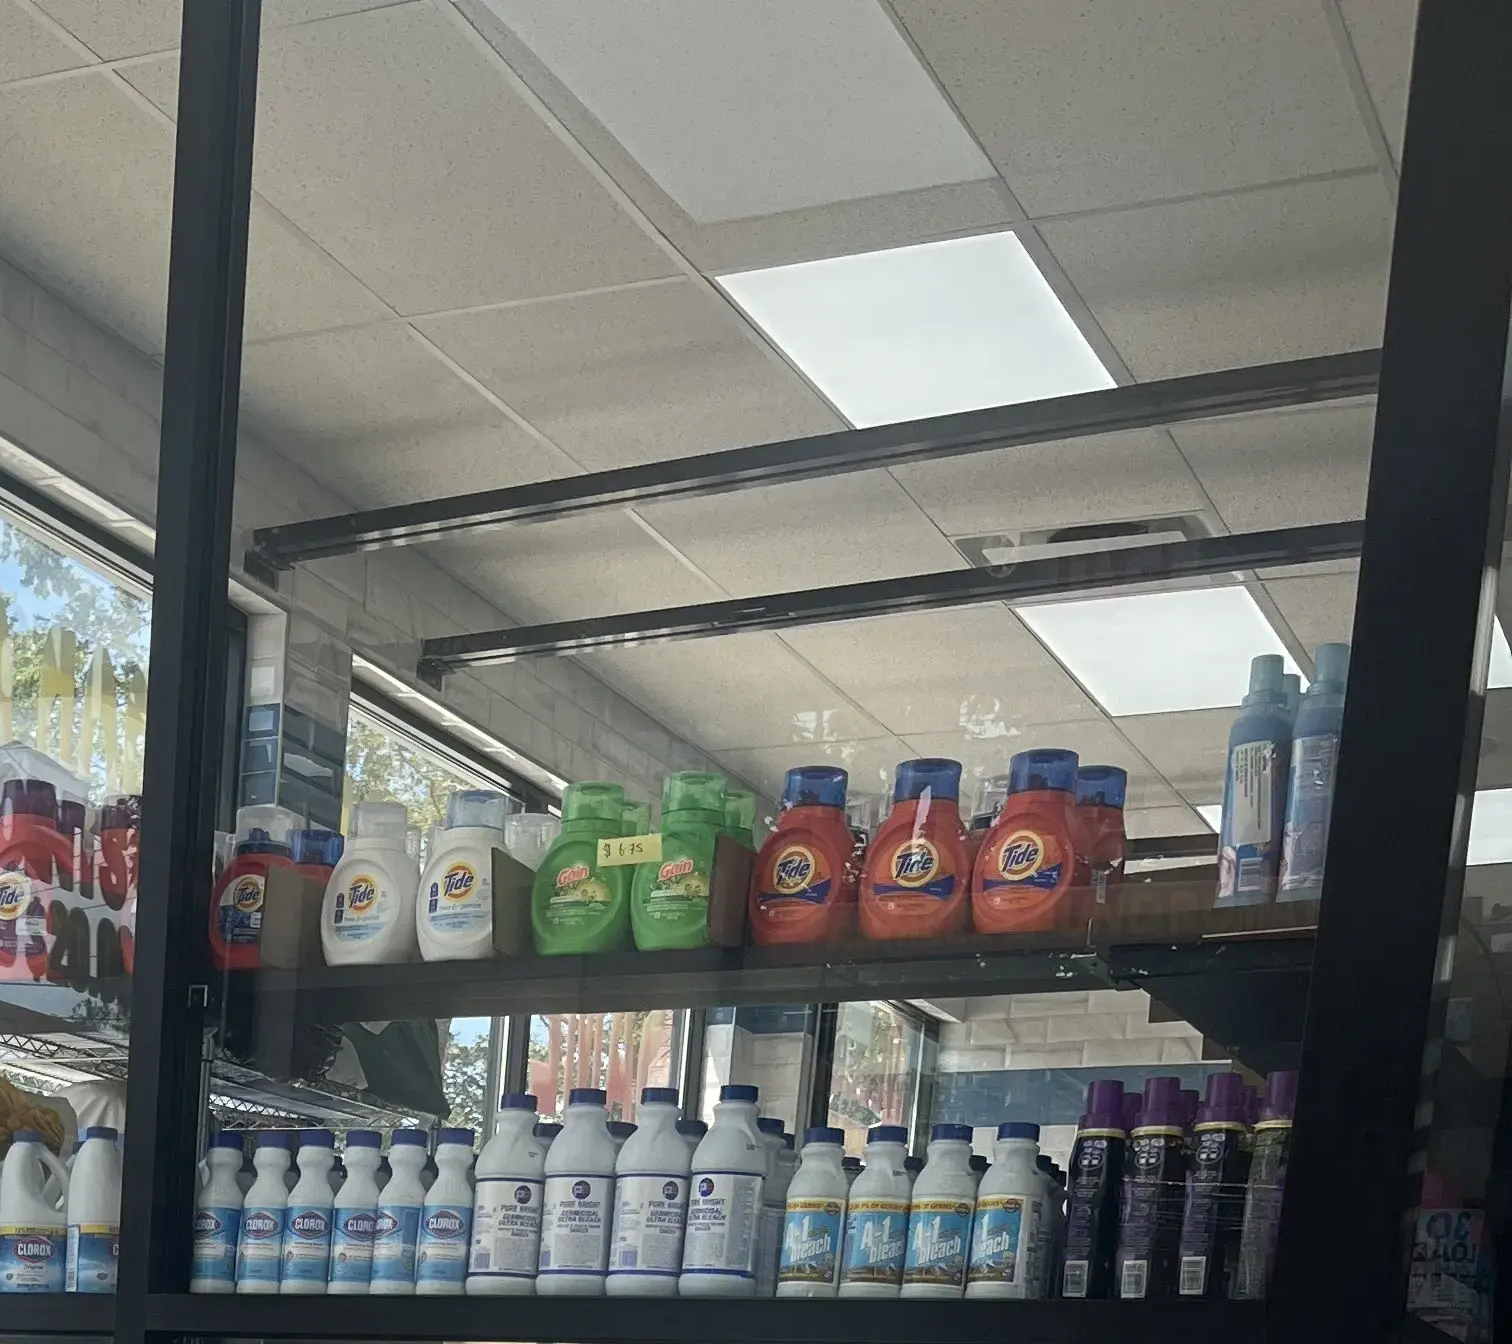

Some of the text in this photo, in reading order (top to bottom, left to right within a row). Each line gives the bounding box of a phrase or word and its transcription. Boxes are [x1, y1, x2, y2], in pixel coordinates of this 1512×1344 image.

[896, 850, 934, 878] Tide
[1003, 844, 1039, 871] Tide
[557, 864, 589, 885] Gain
[659, 859, 693, 880] Gain
[778, 861, 809, 883] Tide
[237, 886, 261, 905] Tide
[444, 872, 475, 896] Tide
[348, 884, 375, 909] Tide
[501, 1205, 518, 1213] PURE
[246, 1219, 275, 1231] CLOROX
[294, 1217, 326, 1231] CLOROX
[428, 1217, 461, 1231] CLOROX
[784, 1215, 810, 1251] A-1
[861, 1214, 892, 1249] A-1
[914, 1215, 941, 1247] A-1
[17, 1242, 51, 1257] CLOROX
[790, 1232, 831, 1264] bleach
[918, 1234, 961, 1265] bleach
